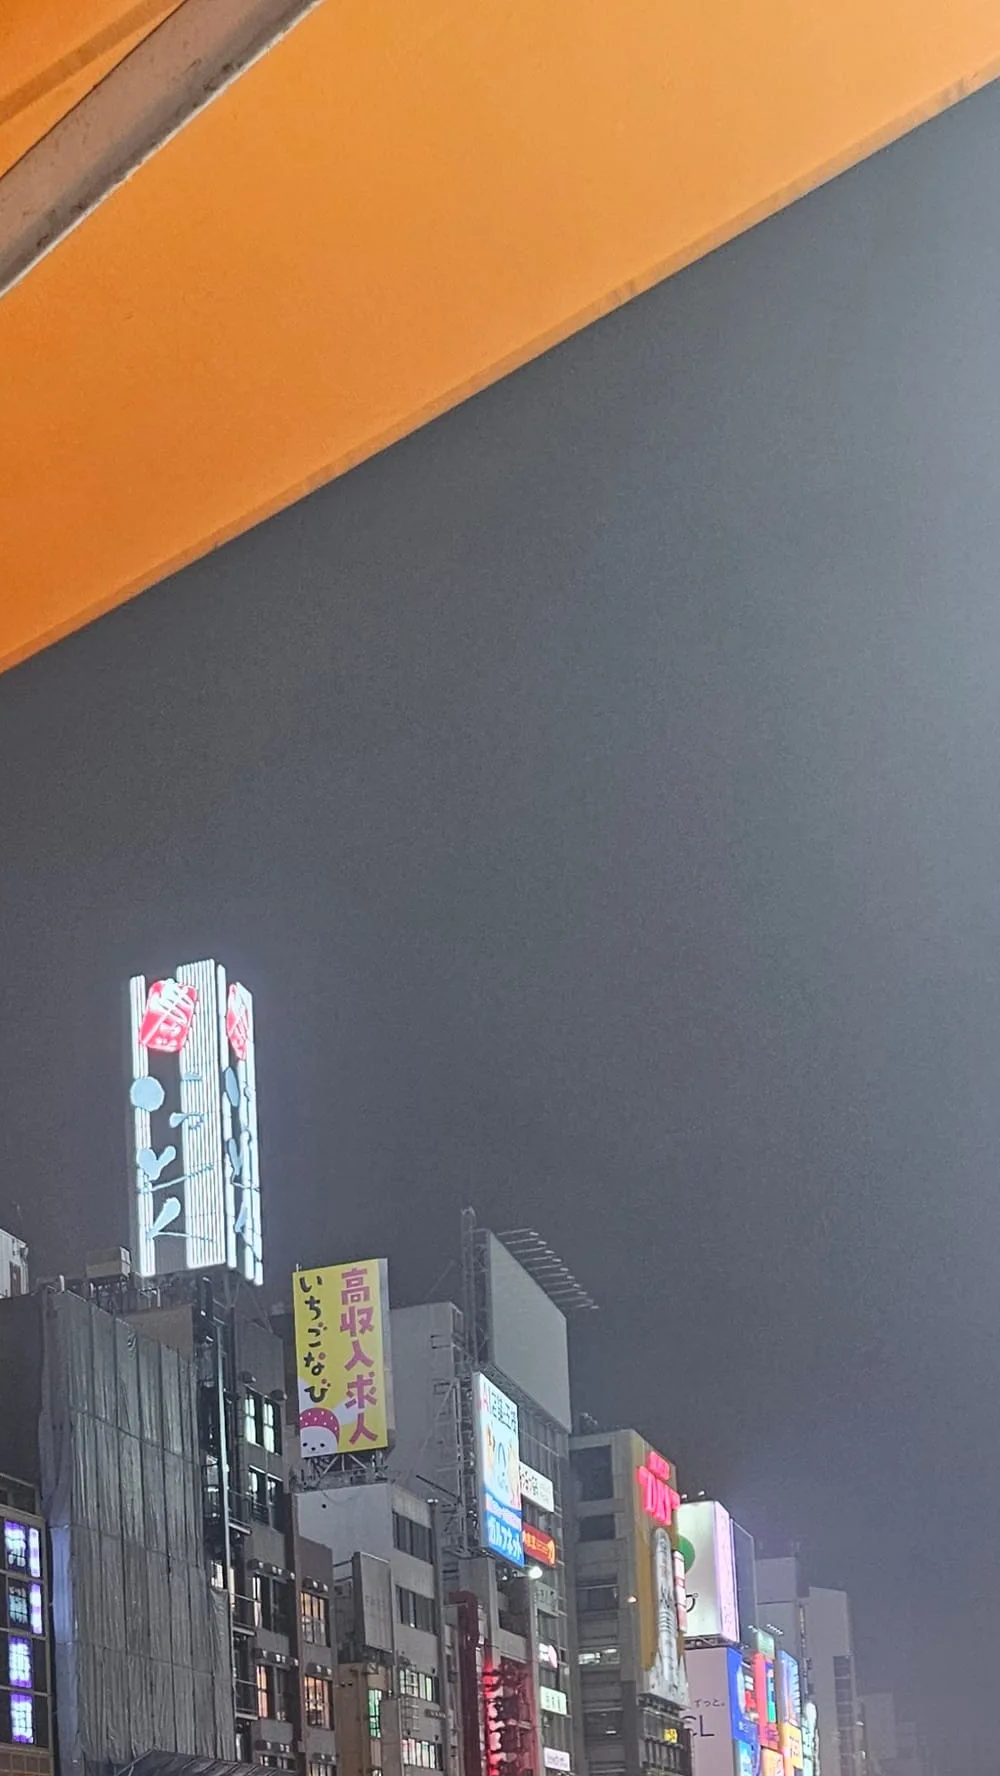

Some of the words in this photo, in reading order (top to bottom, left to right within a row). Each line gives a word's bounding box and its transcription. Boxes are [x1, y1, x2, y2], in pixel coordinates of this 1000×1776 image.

[299, 1275, 332, 1403] いちごなび
[339, 1267, 379, 1445] 高収入求人
